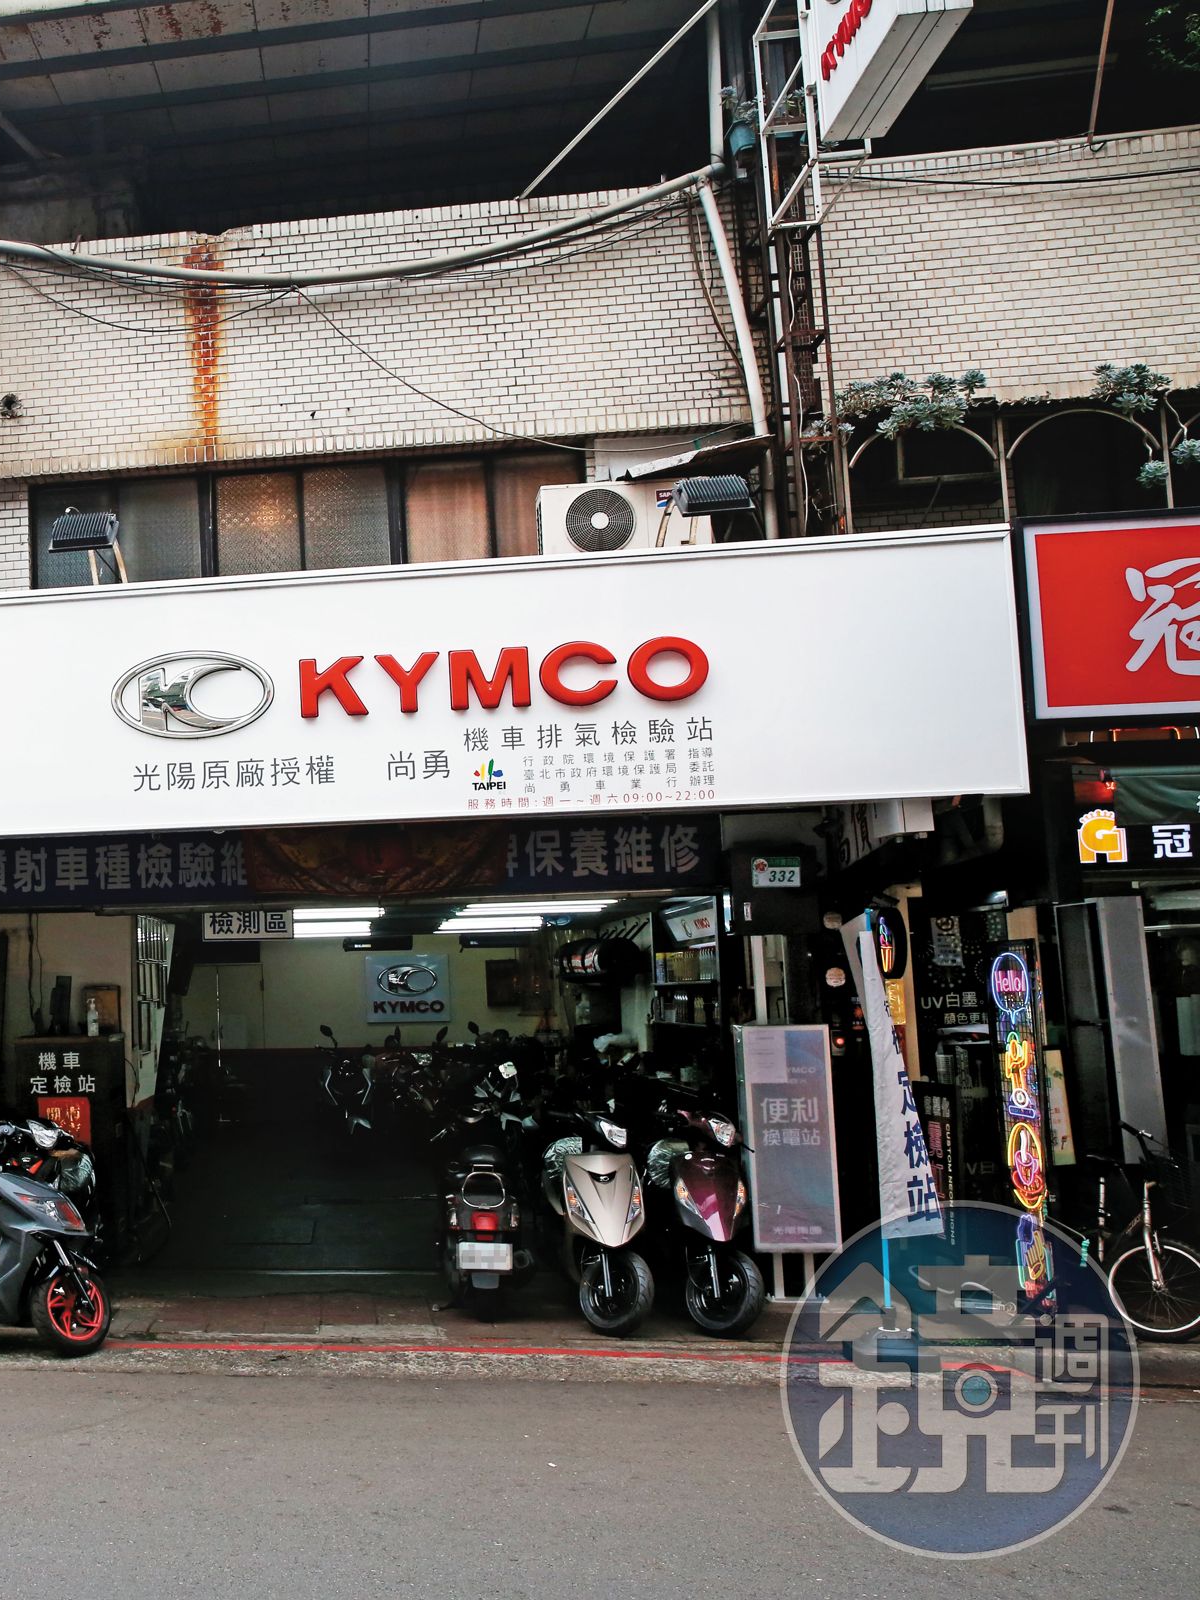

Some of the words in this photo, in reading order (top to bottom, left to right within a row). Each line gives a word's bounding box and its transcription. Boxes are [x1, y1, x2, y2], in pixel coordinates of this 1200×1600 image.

[299, 636, 711, 719] KYMCO
[463, 716, 713, 752] 機車排氣檢驗站
[132, 755, 336, 792] 光陽原廠授權
[386, 749, 451, 781] 尚勇
[472, 781, 506, 791] TAIPEI
[1151, 824, 1193, 858] 冠
[769, 870, 795, 882] 332
[209, 910, 288, 935] 檢測區
[373, 1000, 445, 1014] KYMCO
[38, 1052, 81, 1071] 機車
[30, 1075, 96, 1095] 定檢站
[760, 1097, 819, 1124] 便利
